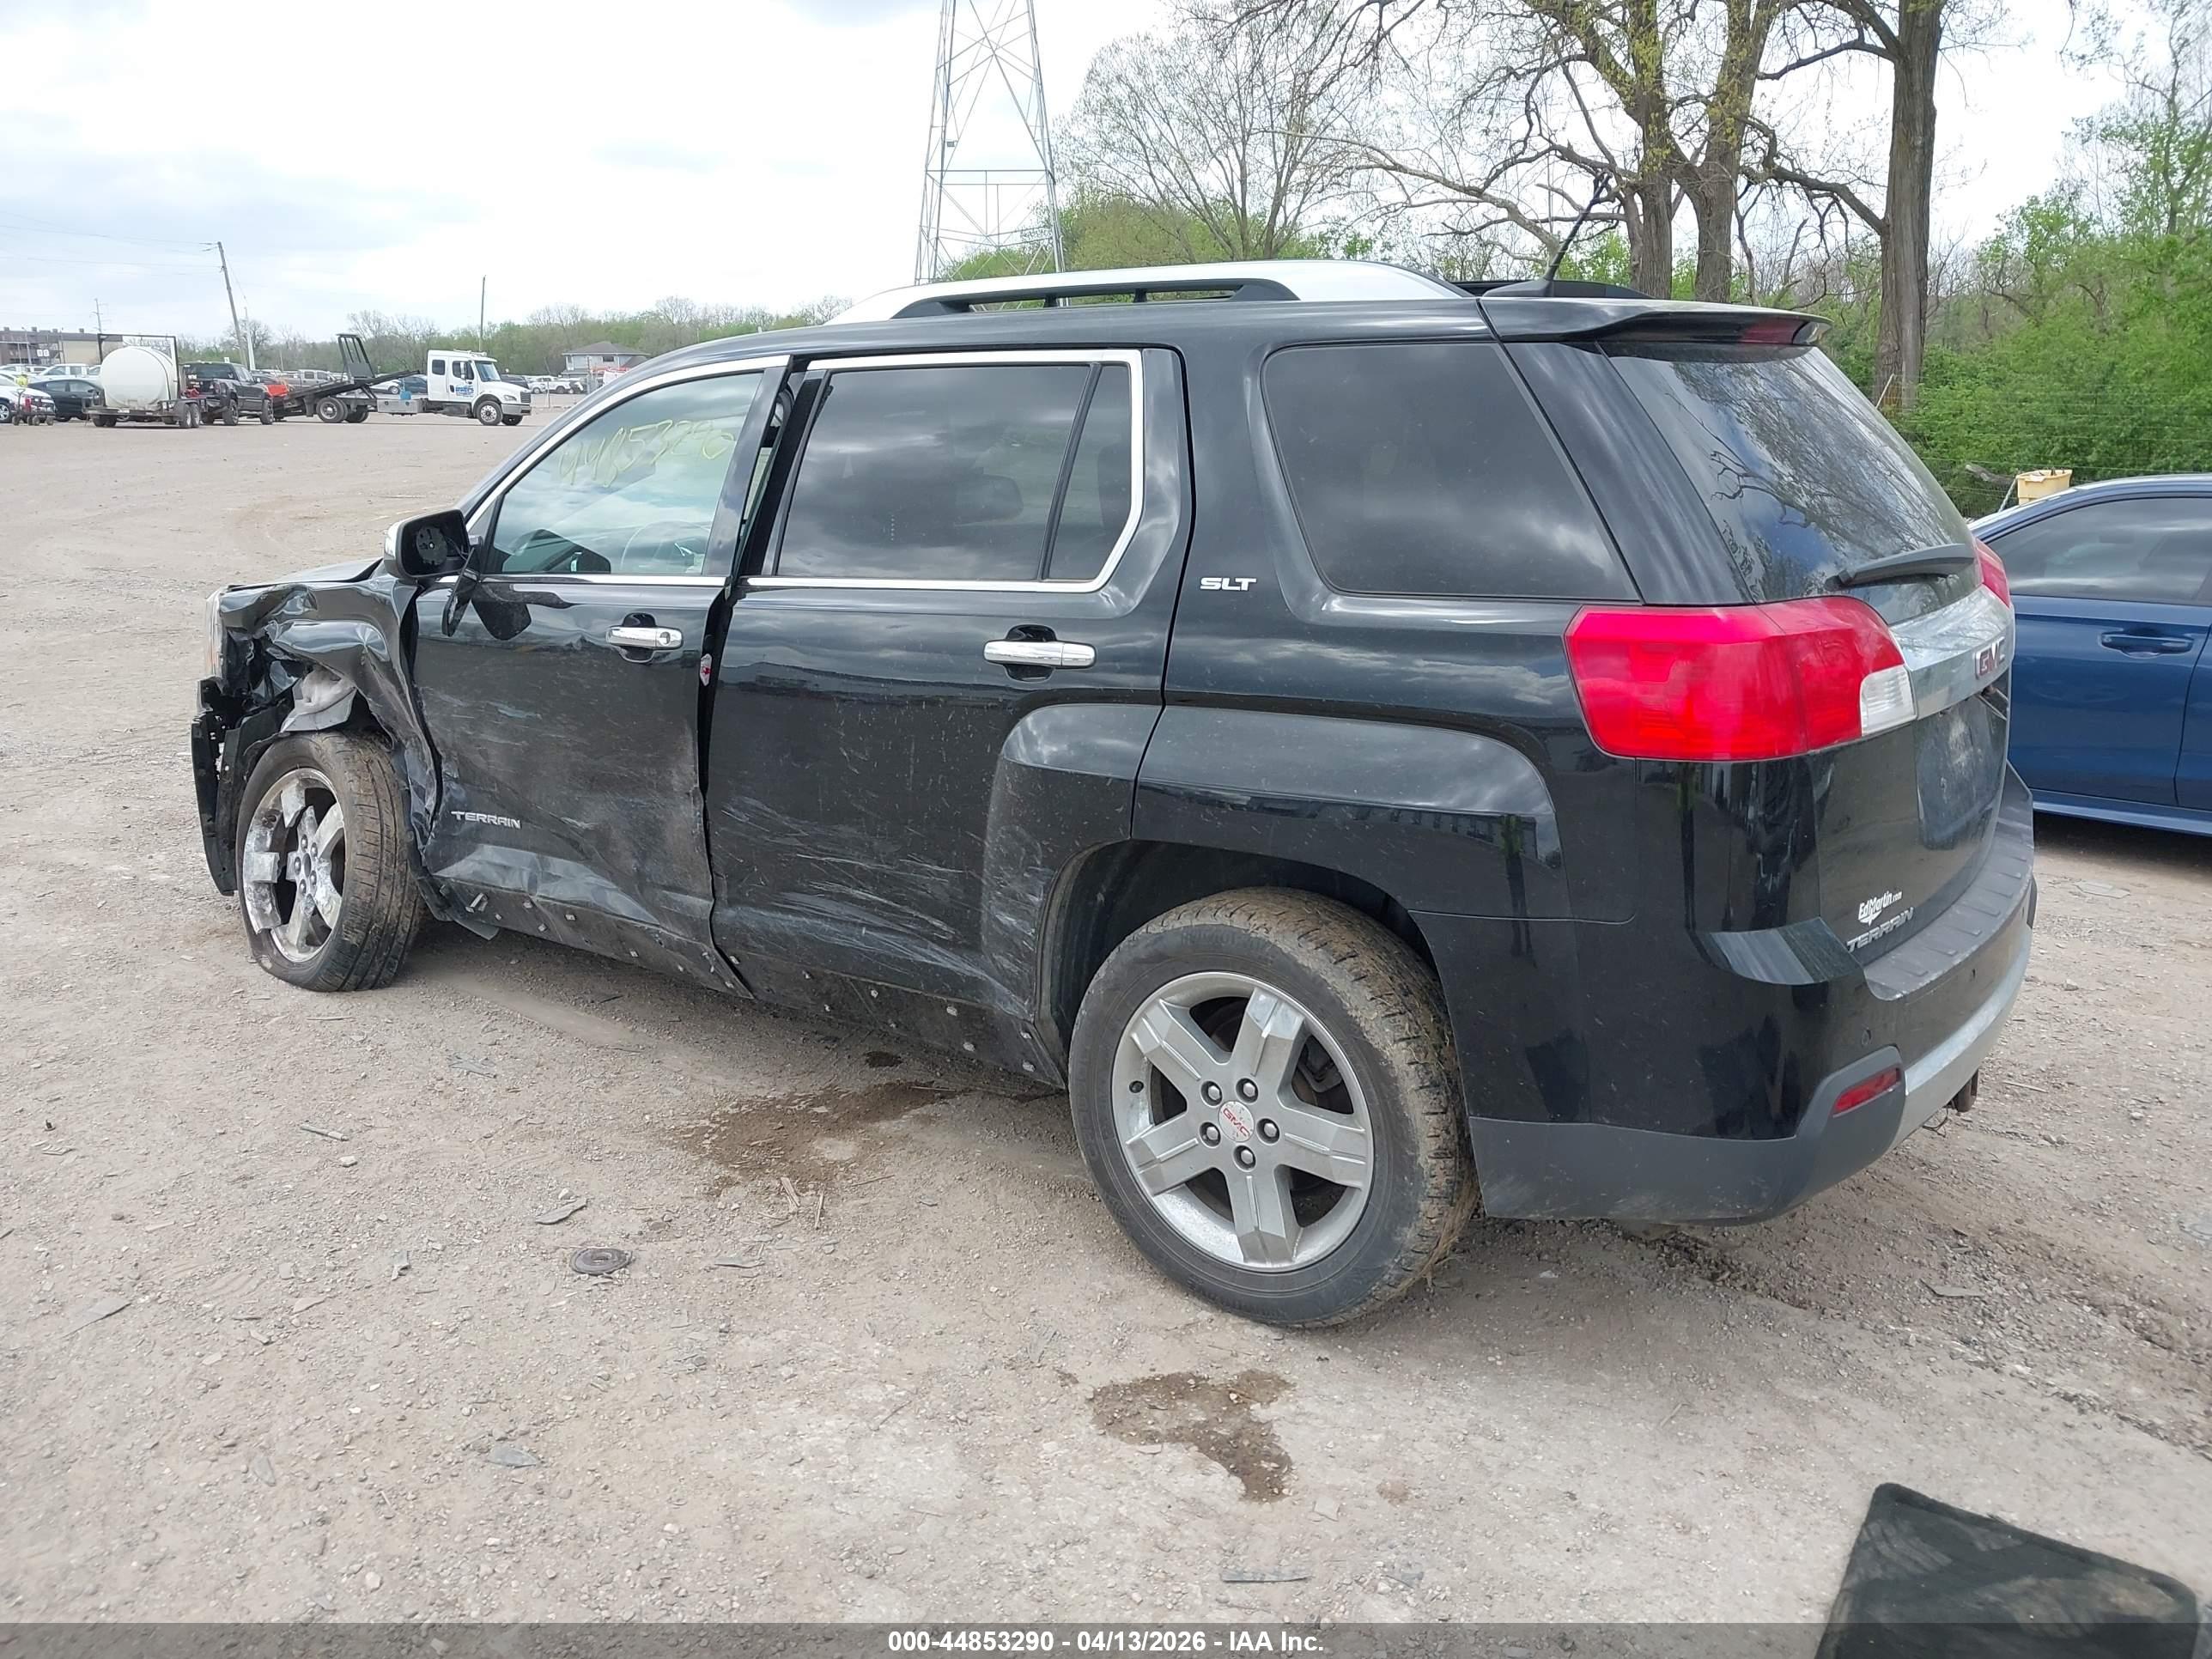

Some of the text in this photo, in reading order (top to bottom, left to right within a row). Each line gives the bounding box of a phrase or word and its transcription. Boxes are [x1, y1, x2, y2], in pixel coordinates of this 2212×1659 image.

[1200, 577, 1257, 592] SLT
[1975, 635, 2006, 678] GMC
[450, 811, 522, 830] TERRAIN
[1846, 906, 1914, 953] TERRAIN
[1223, 1107, 1251, 1139] GMC
